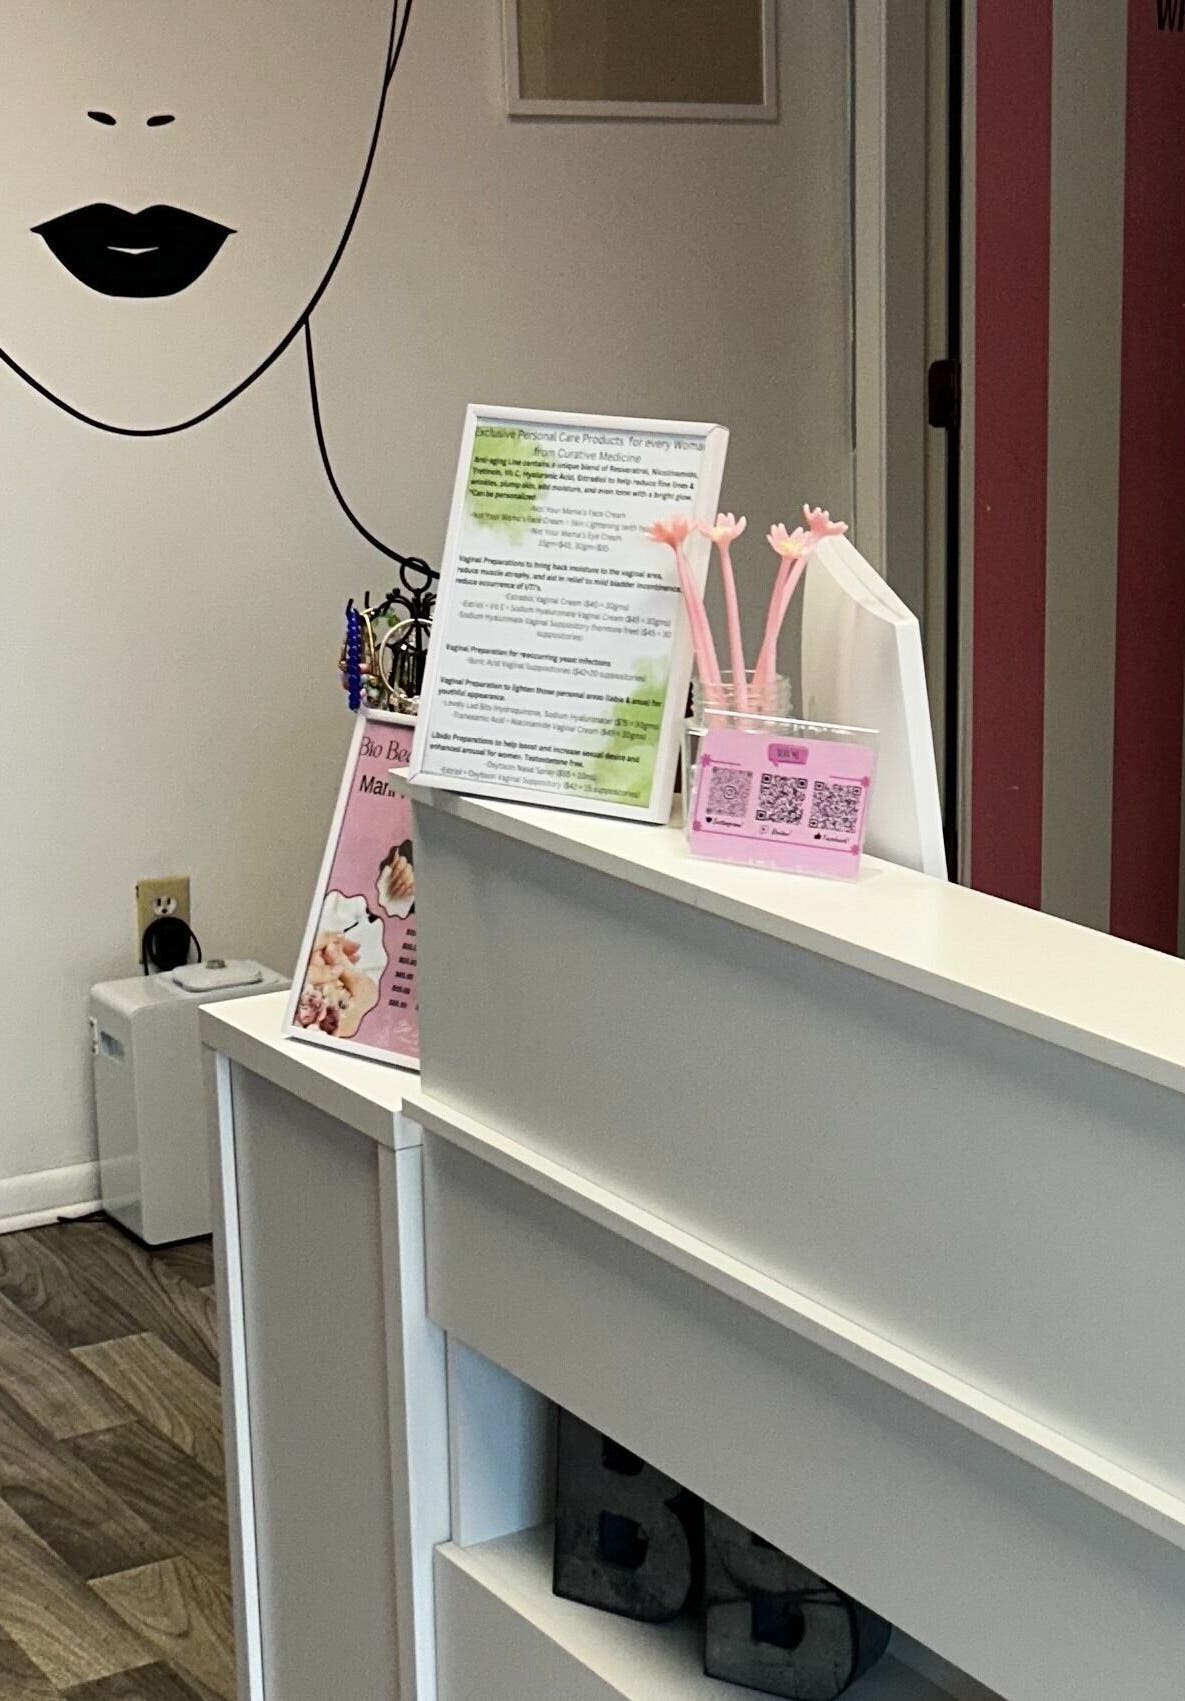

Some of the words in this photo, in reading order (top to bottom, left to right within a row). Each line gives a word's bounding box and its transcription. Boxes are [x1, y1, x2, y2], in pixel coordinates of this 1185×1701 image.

[475, 426, 515, 438] Exclusive
[518, 429, 556, 441] Personal
[560, 432, 579, 442] Care
[582, 434, 623, 445] Products
[629, 437, 643, 446] for
[645, 439, 670, 450] every
[534, 446, 554, 456] from
[557, 448, 596, 459] Curative
[599, 451, 640, 462] Medicine
[360, 736, 383, 758] Bio
